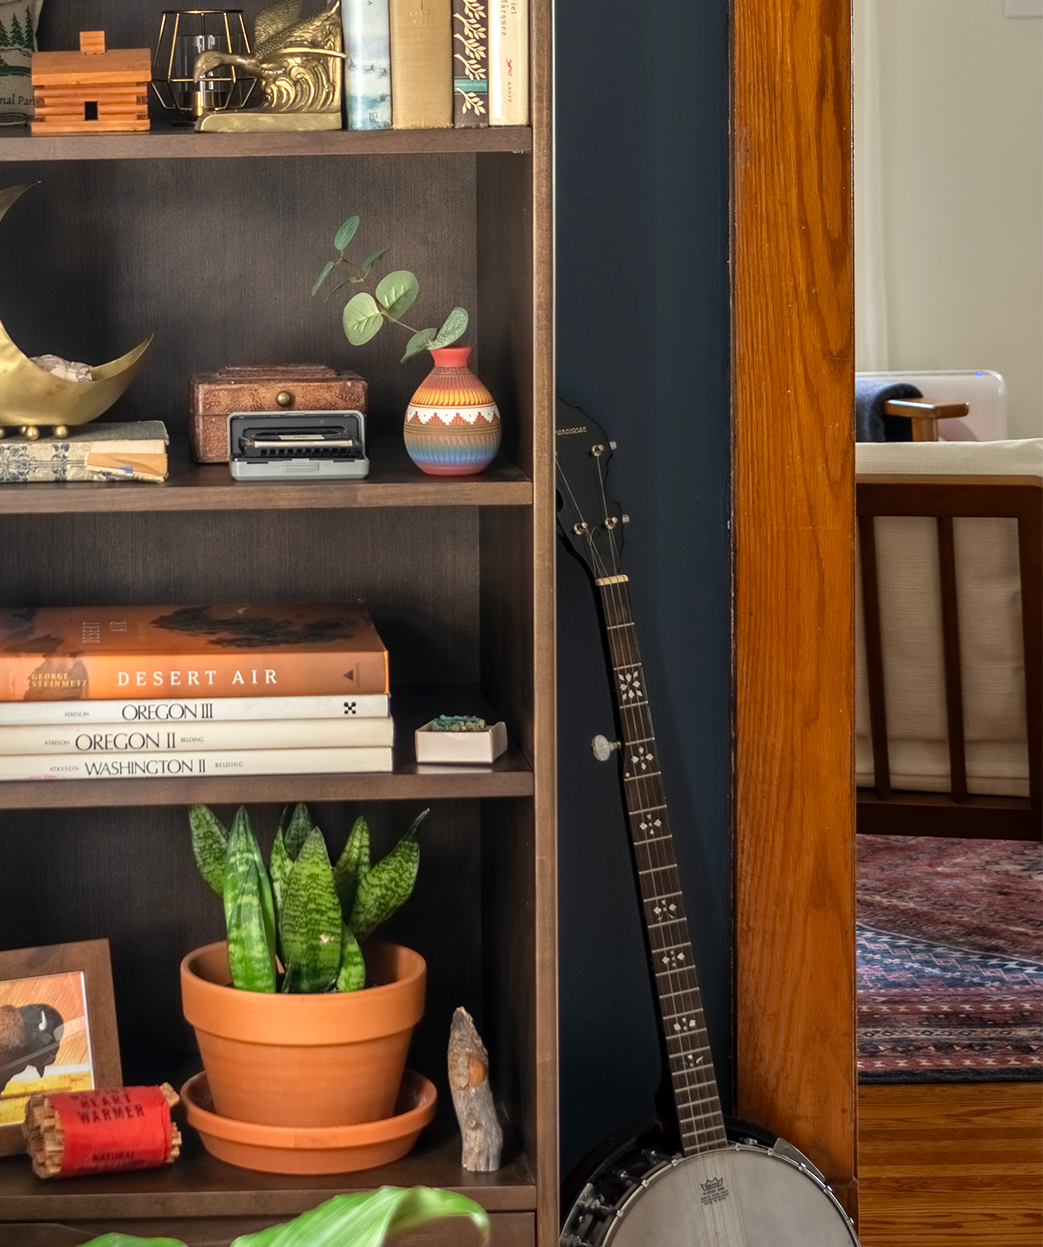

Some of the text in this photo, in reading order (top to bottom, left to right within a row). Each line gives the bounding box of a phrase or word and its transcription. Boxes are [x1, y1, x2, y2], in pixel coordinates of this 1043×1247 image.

[31, 672, 70, 680] GEORGE
[31, 679, 88, 688] STEINMETZ
[117, 669, 278, 686] DESERT AIR
[121, 703, 197, 721] OREGON
[201, 703, 213, 719] III
[75, 732, 160, 751] OREGON
[166, 732, 176, 749] II
[84, 759, 194, 776] WASHINGTON
[198, 759, 206, 773] II
[78, 1103, 145, 1123] WARMER
